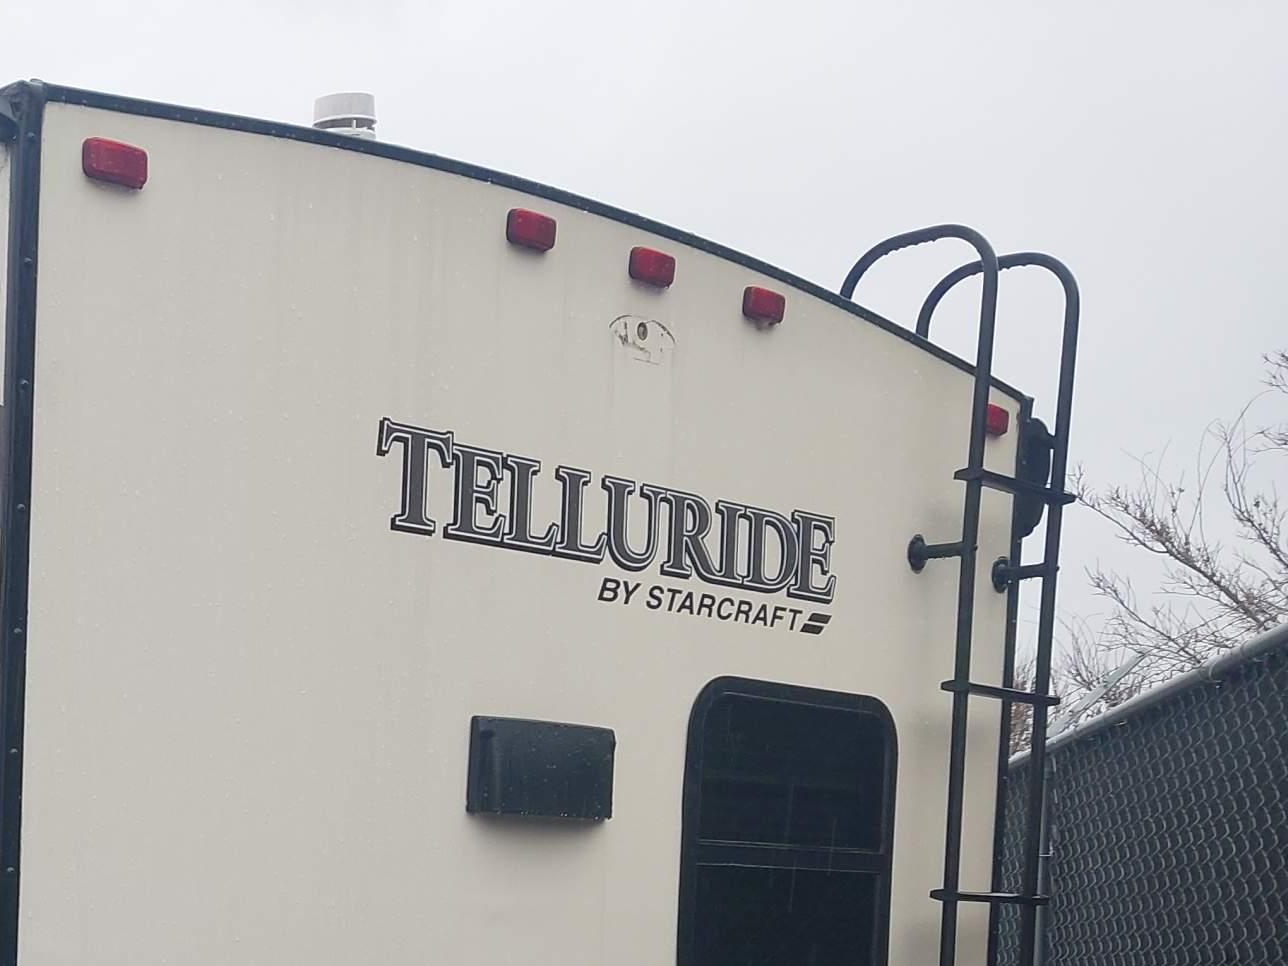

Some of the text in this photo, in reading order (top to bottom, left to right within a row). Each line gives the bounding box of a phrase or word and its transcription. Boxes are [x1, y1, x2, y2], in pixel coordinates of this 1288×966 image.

[376, 416, 837, 604] TELLURIDE
[598, 577, 804, 632] BY STARCRAFT
